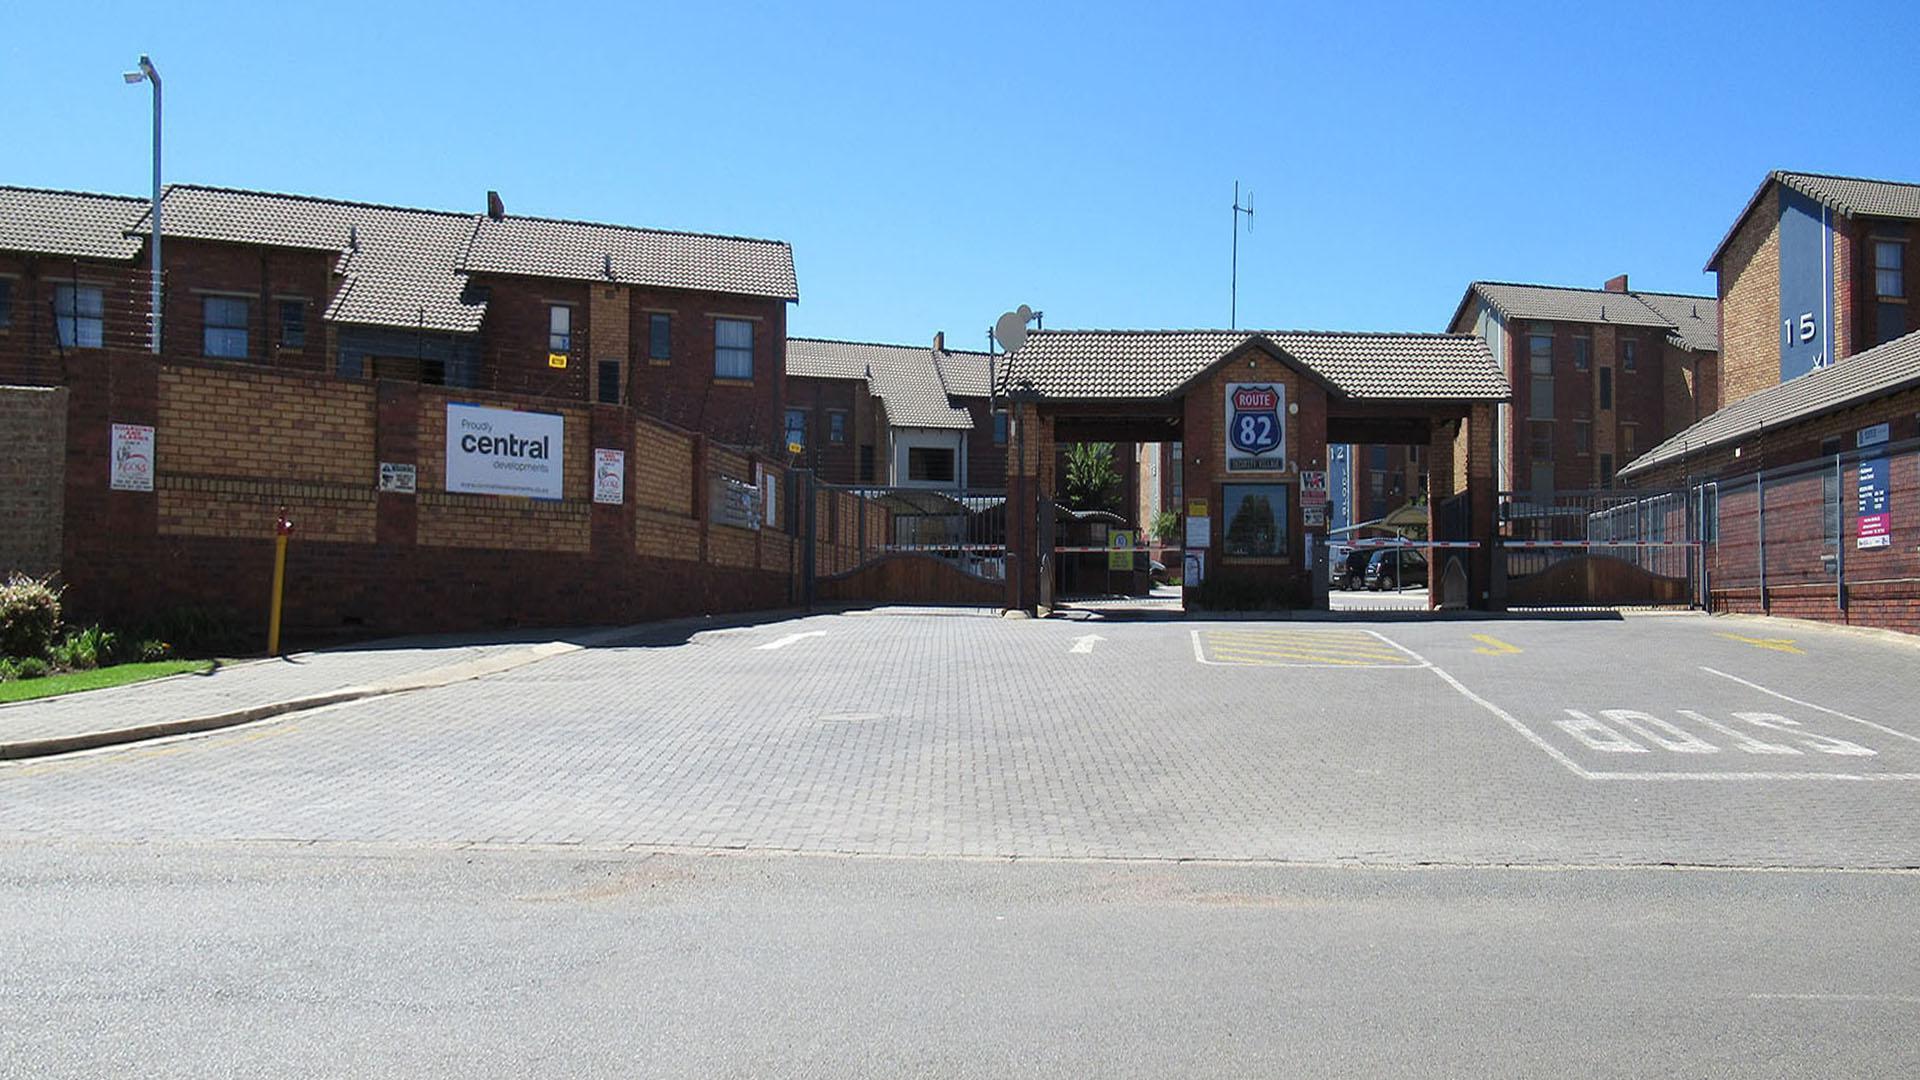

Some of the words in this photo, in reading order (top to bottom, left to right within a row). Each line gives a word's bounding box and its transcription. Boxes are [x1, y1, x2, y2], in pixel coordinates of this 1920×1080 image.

[1784, 312, 1816, 344] 15
[1239, 394, 1270, 406] ROUTE
[461, 418, 493, 432] Proudly
[1240, 415, 1272, 445] 82
[461, 433, 549, 460] central
[1330, 446, 1344, 460] 12
[492, 460, 549, 473] developments
[1552, 708, 1879, 755] STOP
